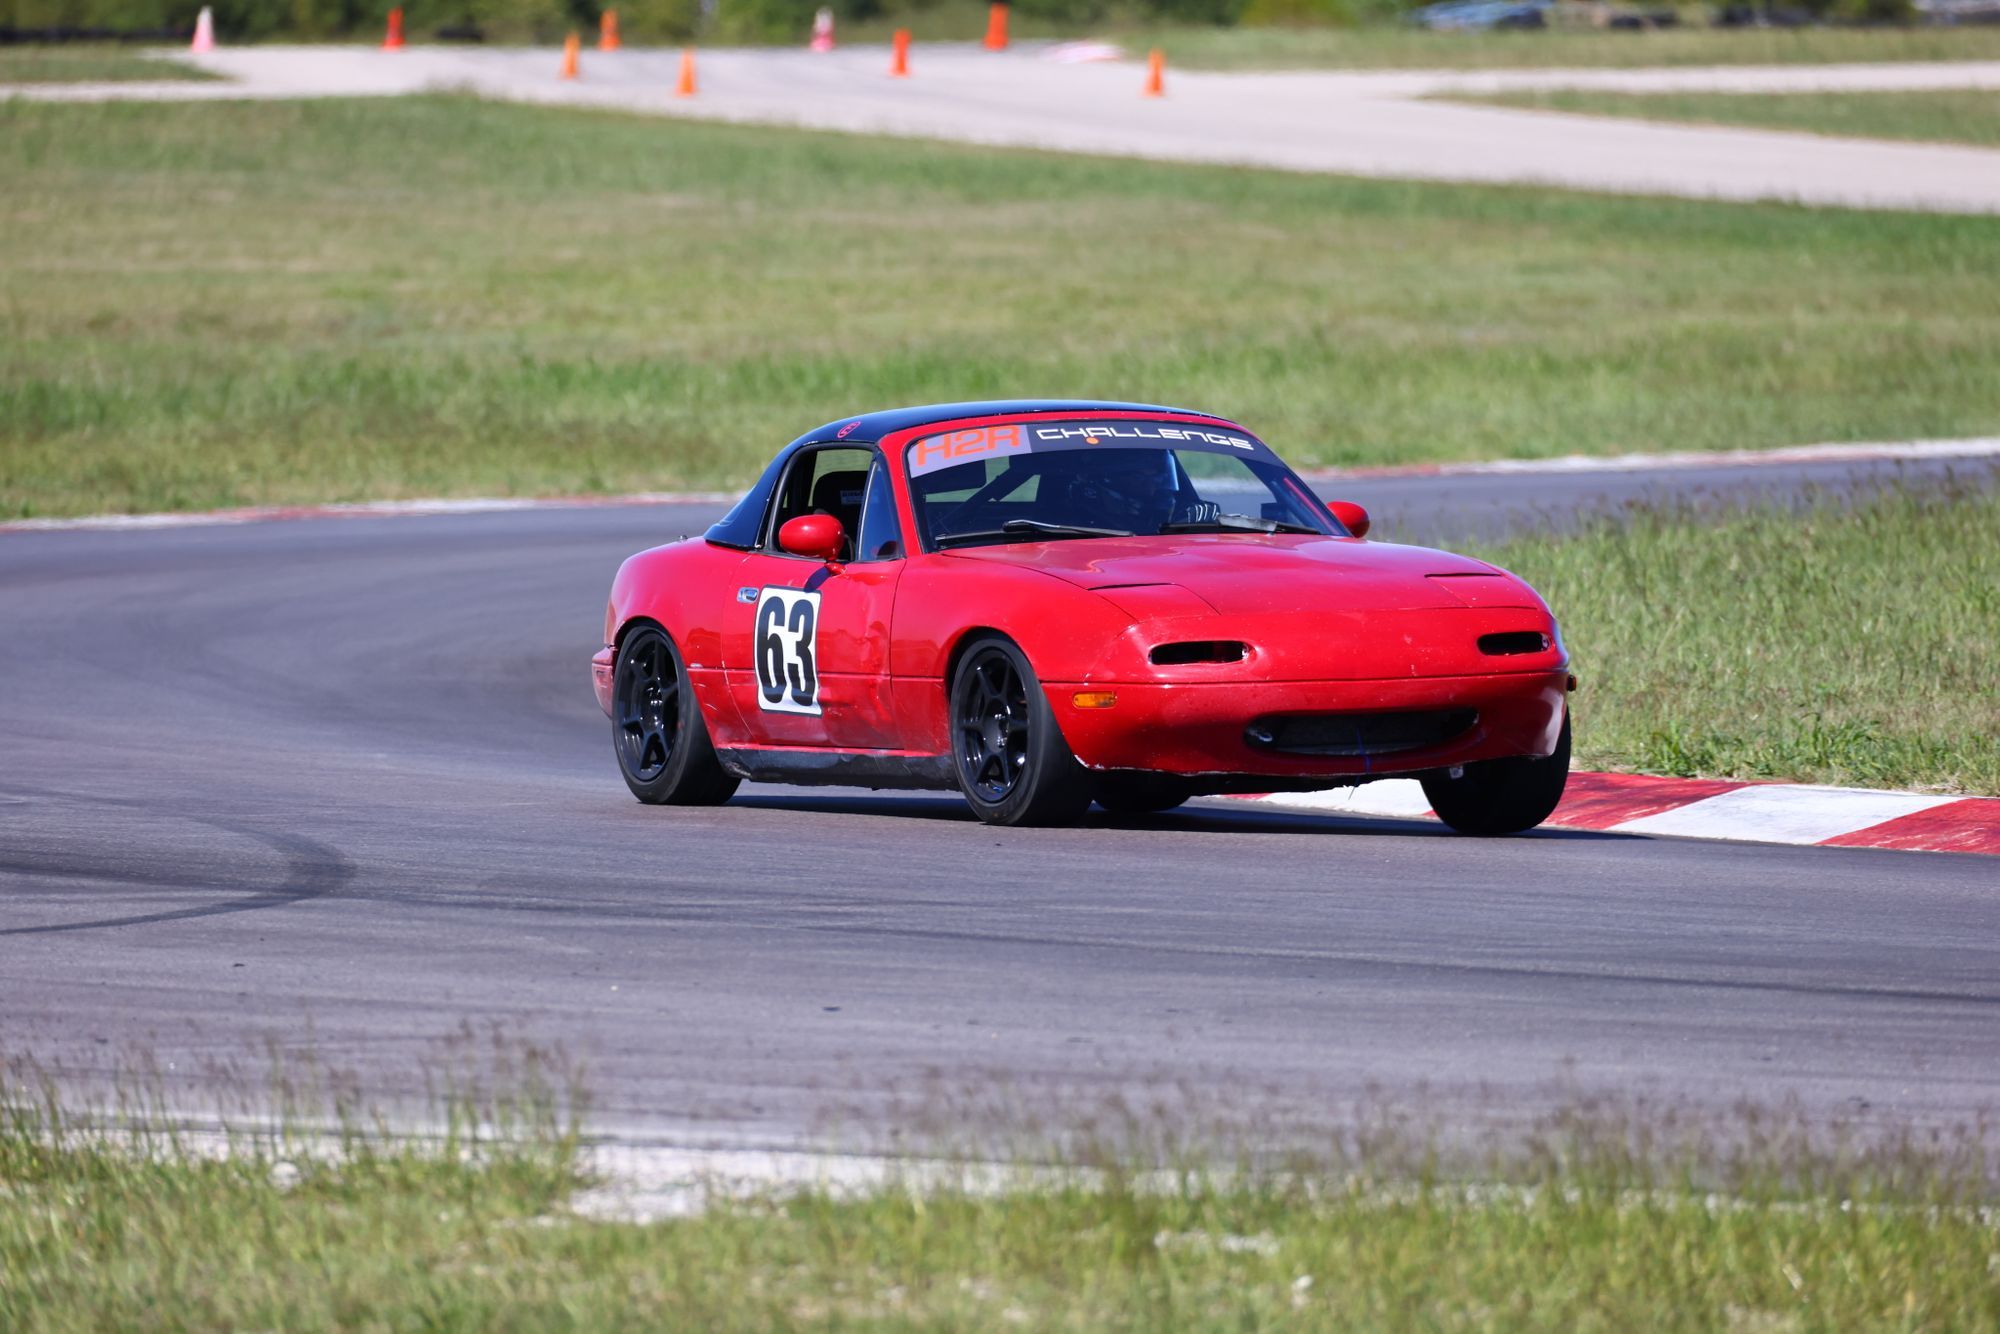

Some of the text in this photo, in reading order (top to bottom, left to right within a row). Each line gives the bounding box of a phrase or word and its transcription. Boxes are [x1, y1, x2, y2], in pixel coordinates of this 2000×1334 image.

[916, 425, 1254, 467] H2R CHALLENGE
[757, 596, 815, 706] 63
